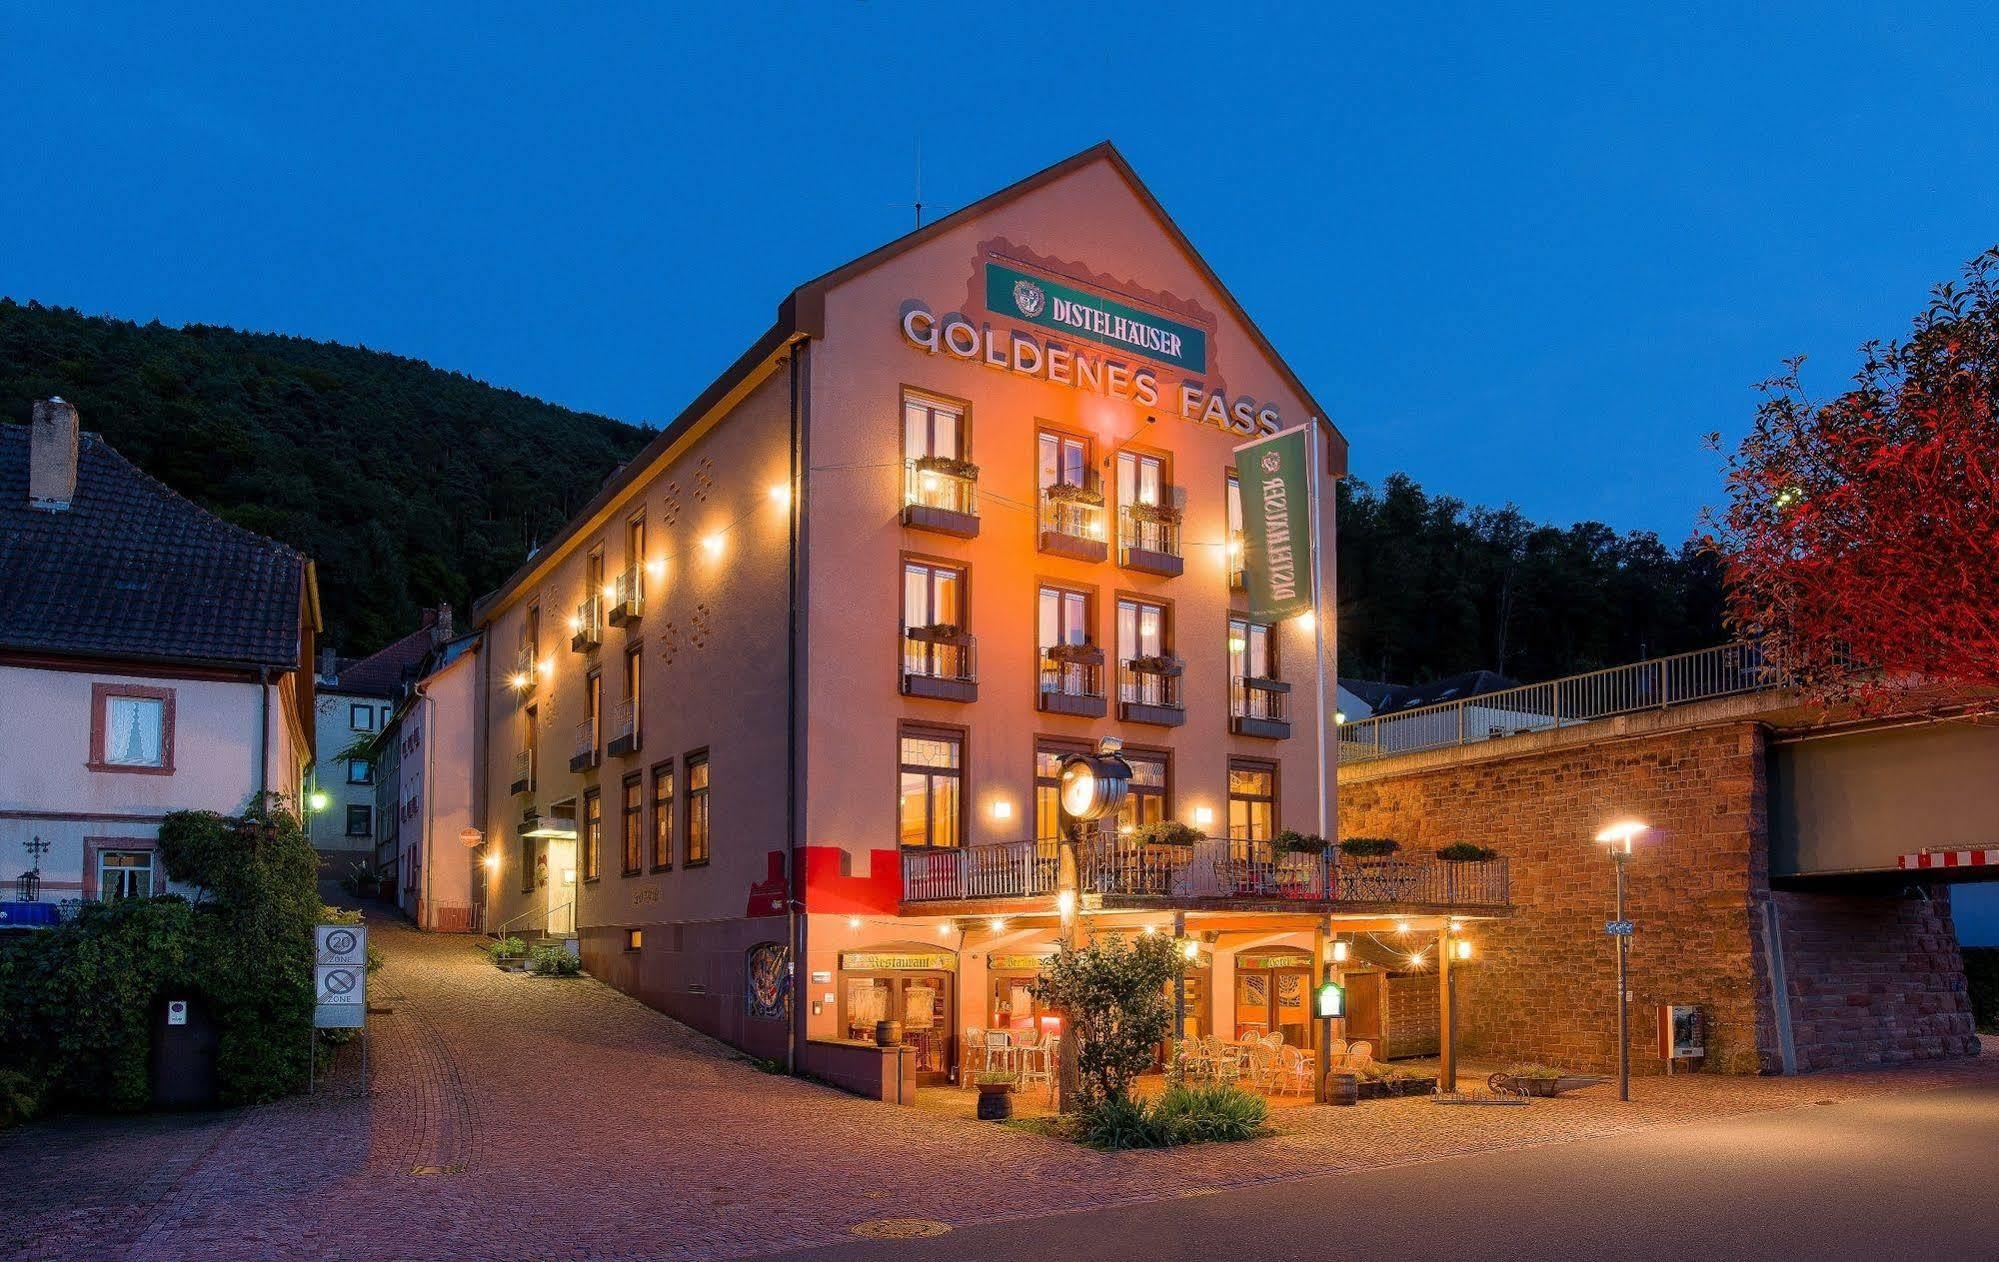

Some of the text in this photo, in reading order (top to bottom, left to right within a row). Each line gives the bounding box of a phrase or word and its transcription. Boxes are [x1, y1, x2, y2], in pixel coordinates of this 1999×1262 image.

[1052, 296, 1182, 359] DISTELHÄUSER
[903, 310, 1279, 438] GOLDENES FASS
[333, 936, 350, 948] 20
[868, 955, 929, 968] Restaurant
[328, 995, 352, 1003] ZONE
